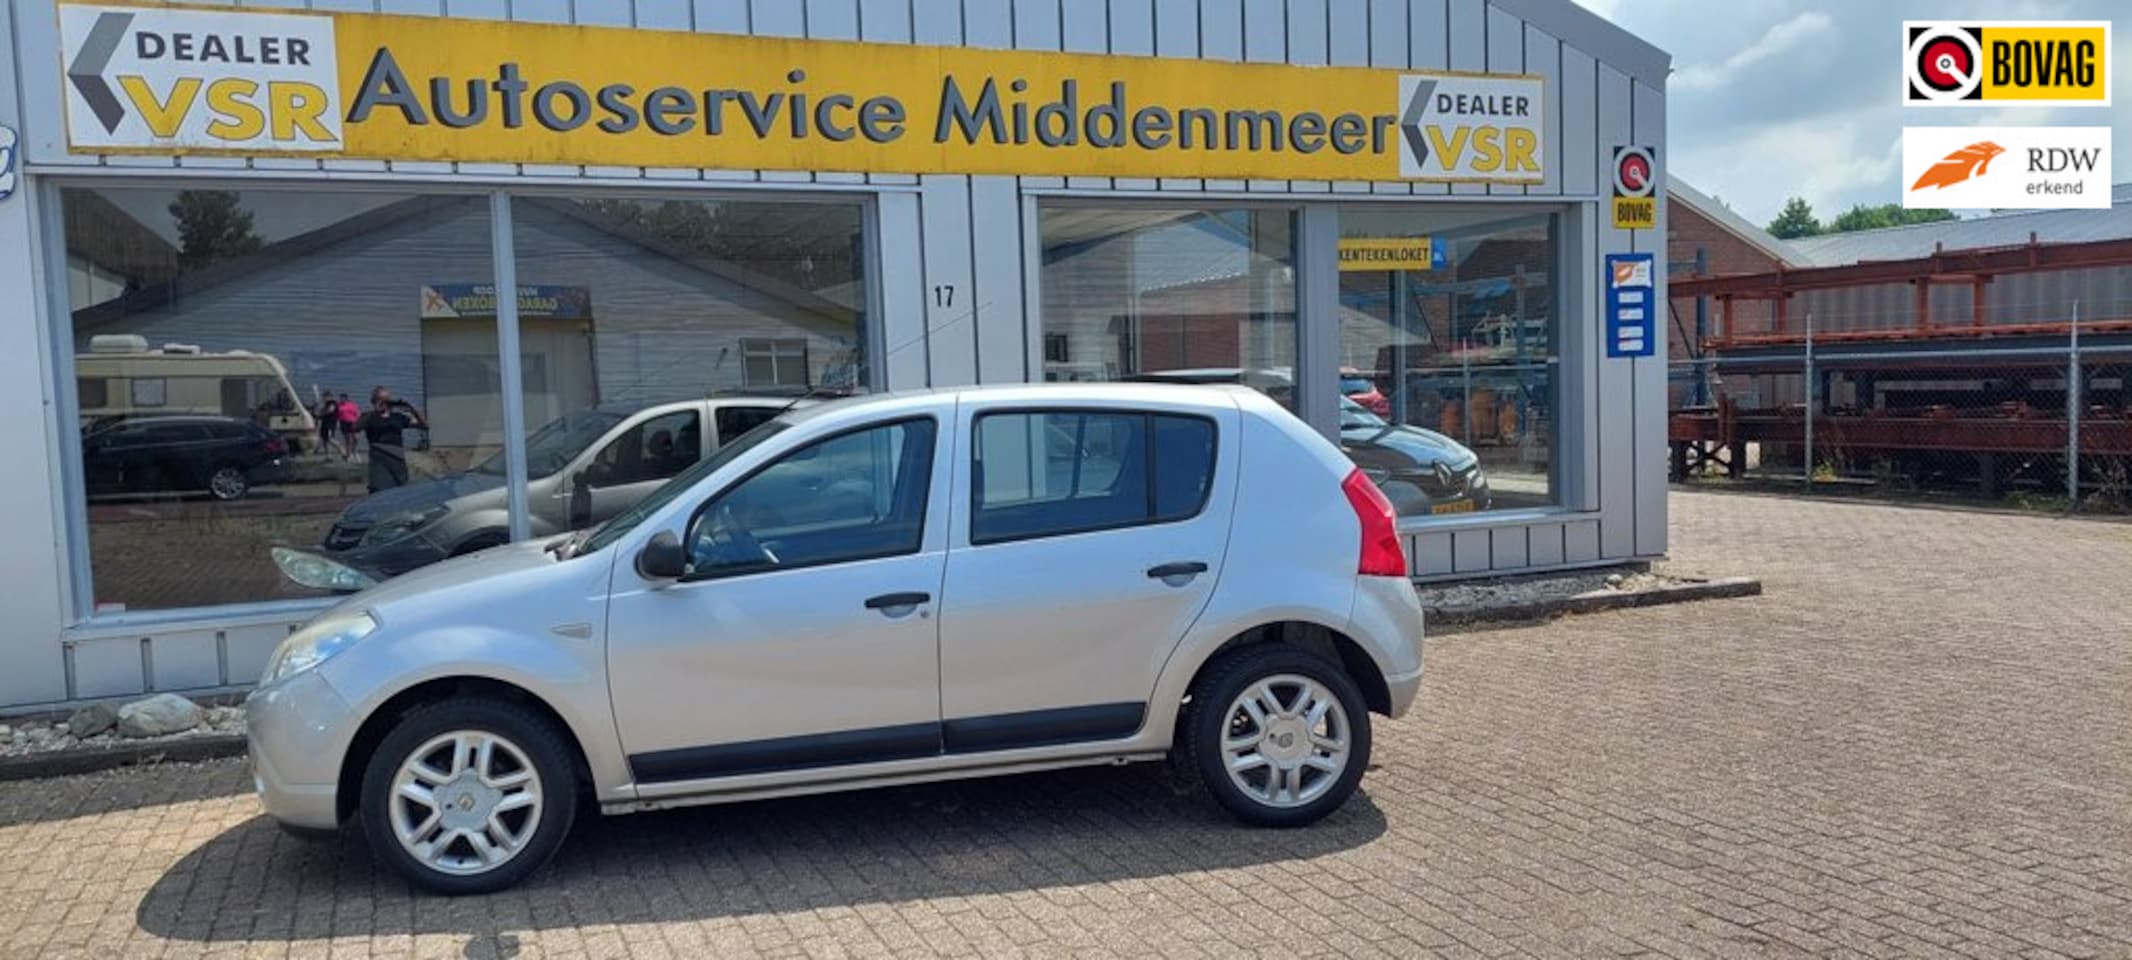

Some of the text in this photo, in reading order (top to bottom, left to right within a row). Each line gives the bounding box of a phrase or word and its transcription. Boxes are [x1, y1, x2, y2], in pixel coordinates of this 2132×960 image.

[136, 31, 311, 66] DEALER
[116, 75, 339, 142] VSR
[346, 46, 1397, 155] Autoservice Middenmeer
[1437, 93, 1529, 117] DEALER
[1425, 124, 1541, 172] VSR
[1617, 202, 1652, 223] BOVAG
[934, 285, 954, 308] 17
